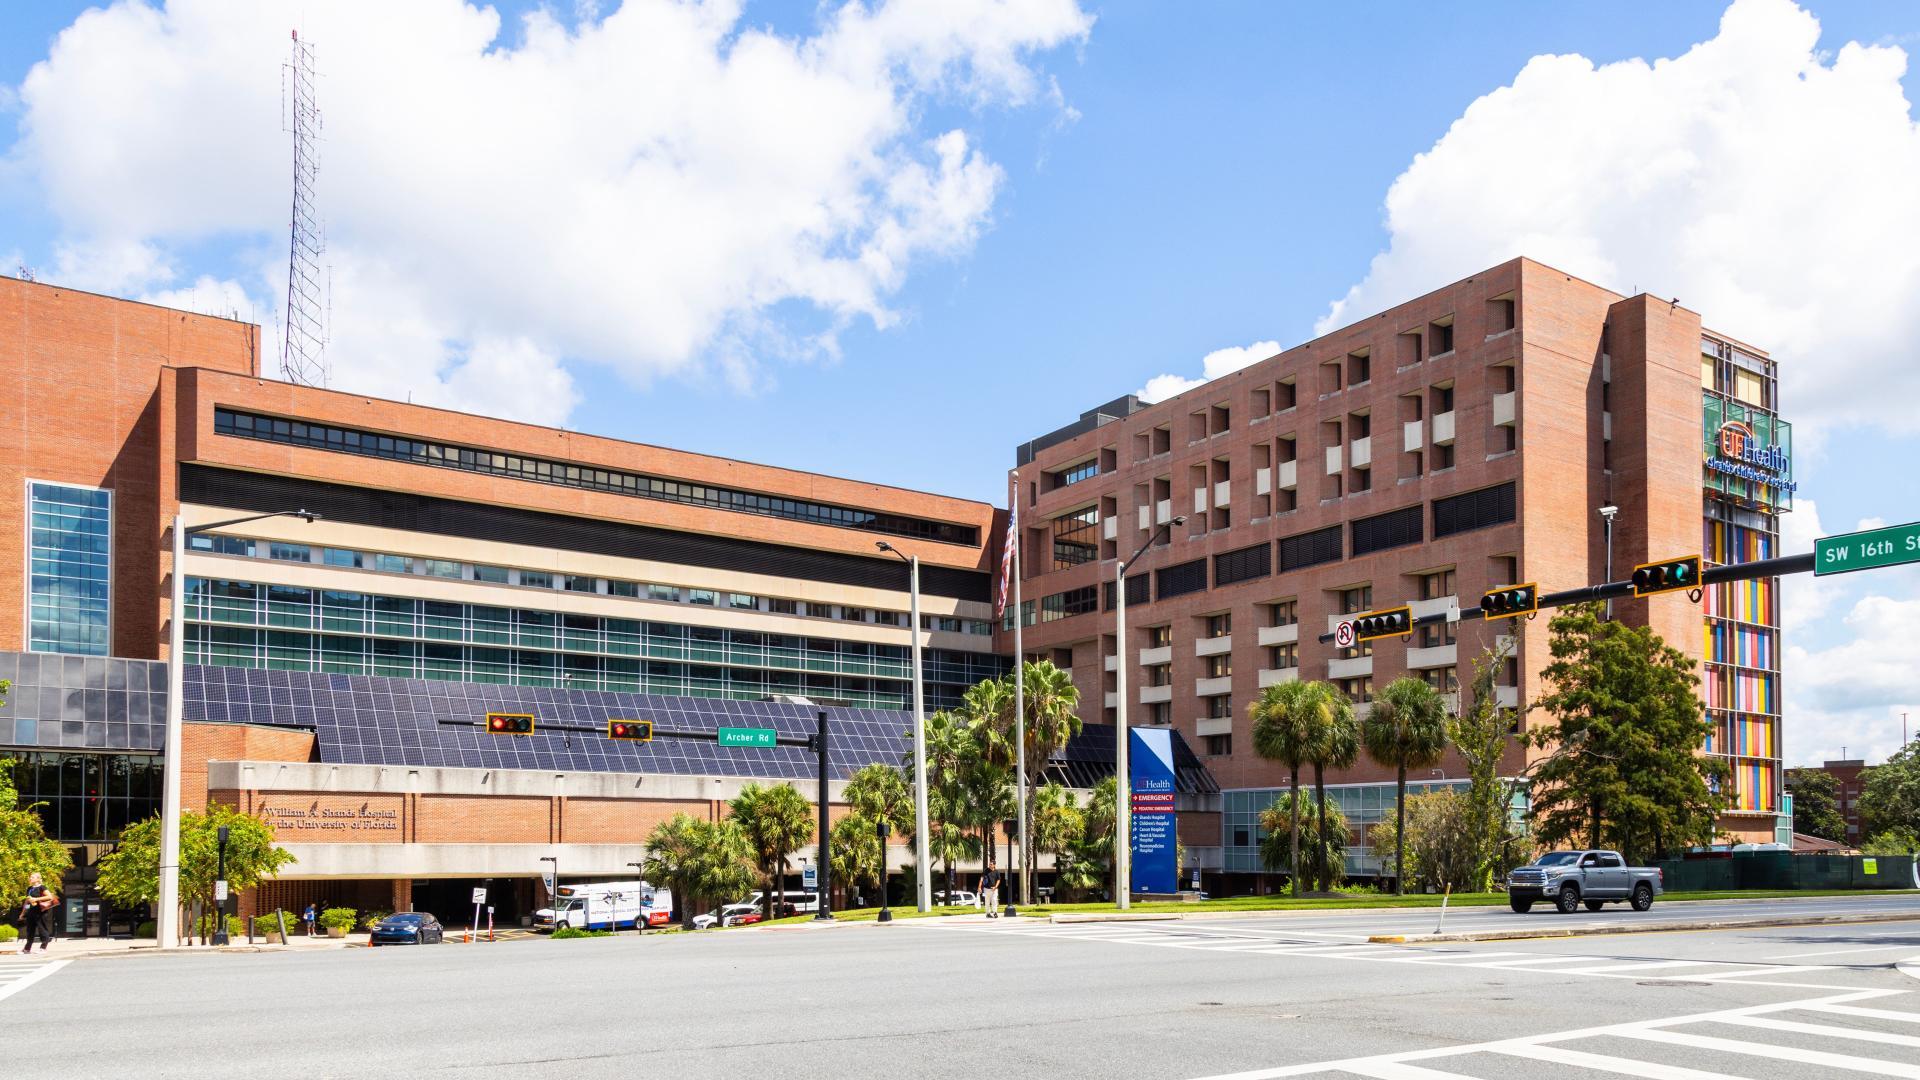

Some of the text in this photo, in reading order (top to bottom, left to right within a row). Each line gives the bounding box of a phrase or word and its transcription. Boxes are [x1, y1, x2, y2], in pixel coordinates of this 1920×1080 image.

[1825, 545, 1849, 563] SW
[1860, 540, 1893, 558] 16th
[726, 733, 769, 743] Archer Rd
[264, 807, 306, 818] William
[322, 809, 356, 818] Shands
[358, 809, 397, 821] Hospital
[276, 819, 294, 829] the
[296, 820, 348, 832] University
[350, 820, 361, 830] of
[362, 820, 397, 830] Florida
